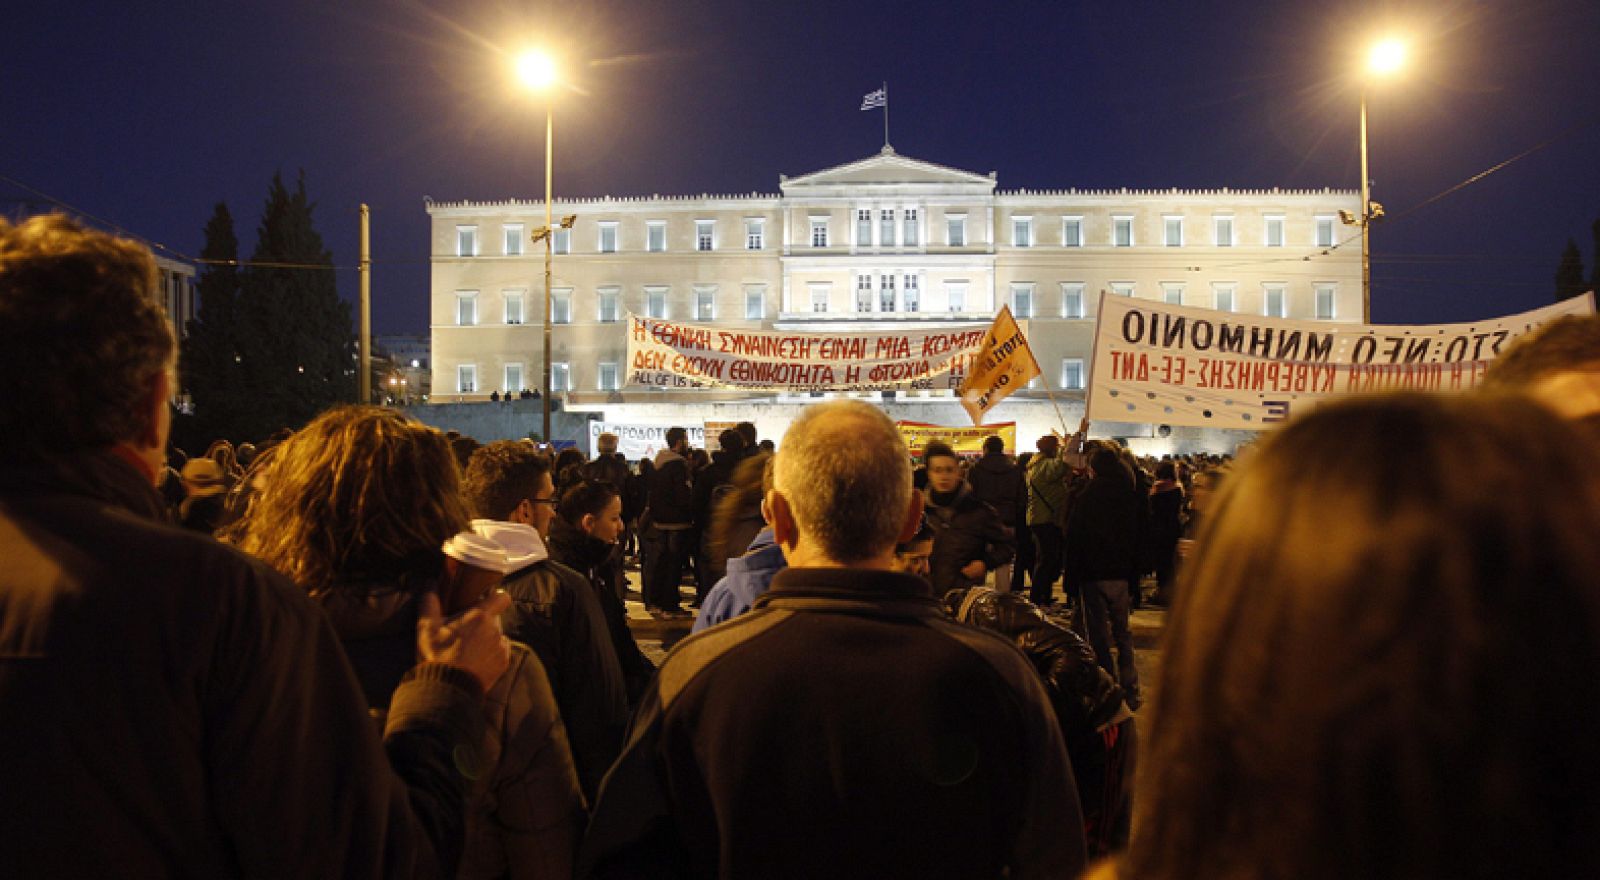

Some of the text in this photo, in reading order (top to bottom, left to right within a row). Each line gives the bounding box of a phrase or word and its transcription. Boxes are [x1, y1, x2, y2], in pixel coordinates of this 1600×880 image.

[633, 317, 646, 342] Η
[819, 337, 867, 360] ΕΙΝΑΙ
[875, 335, 911, 360] ΜΙΑ
[633, 350, 666, 370] ΔΕΝ
[729, 359, 835, 384] ΕΘΝΙΚΟΤΗΤΑ
[845, 366, 860, 384] Η
[613, 426, 668, 441] ΠΡΟΔΟΤ
